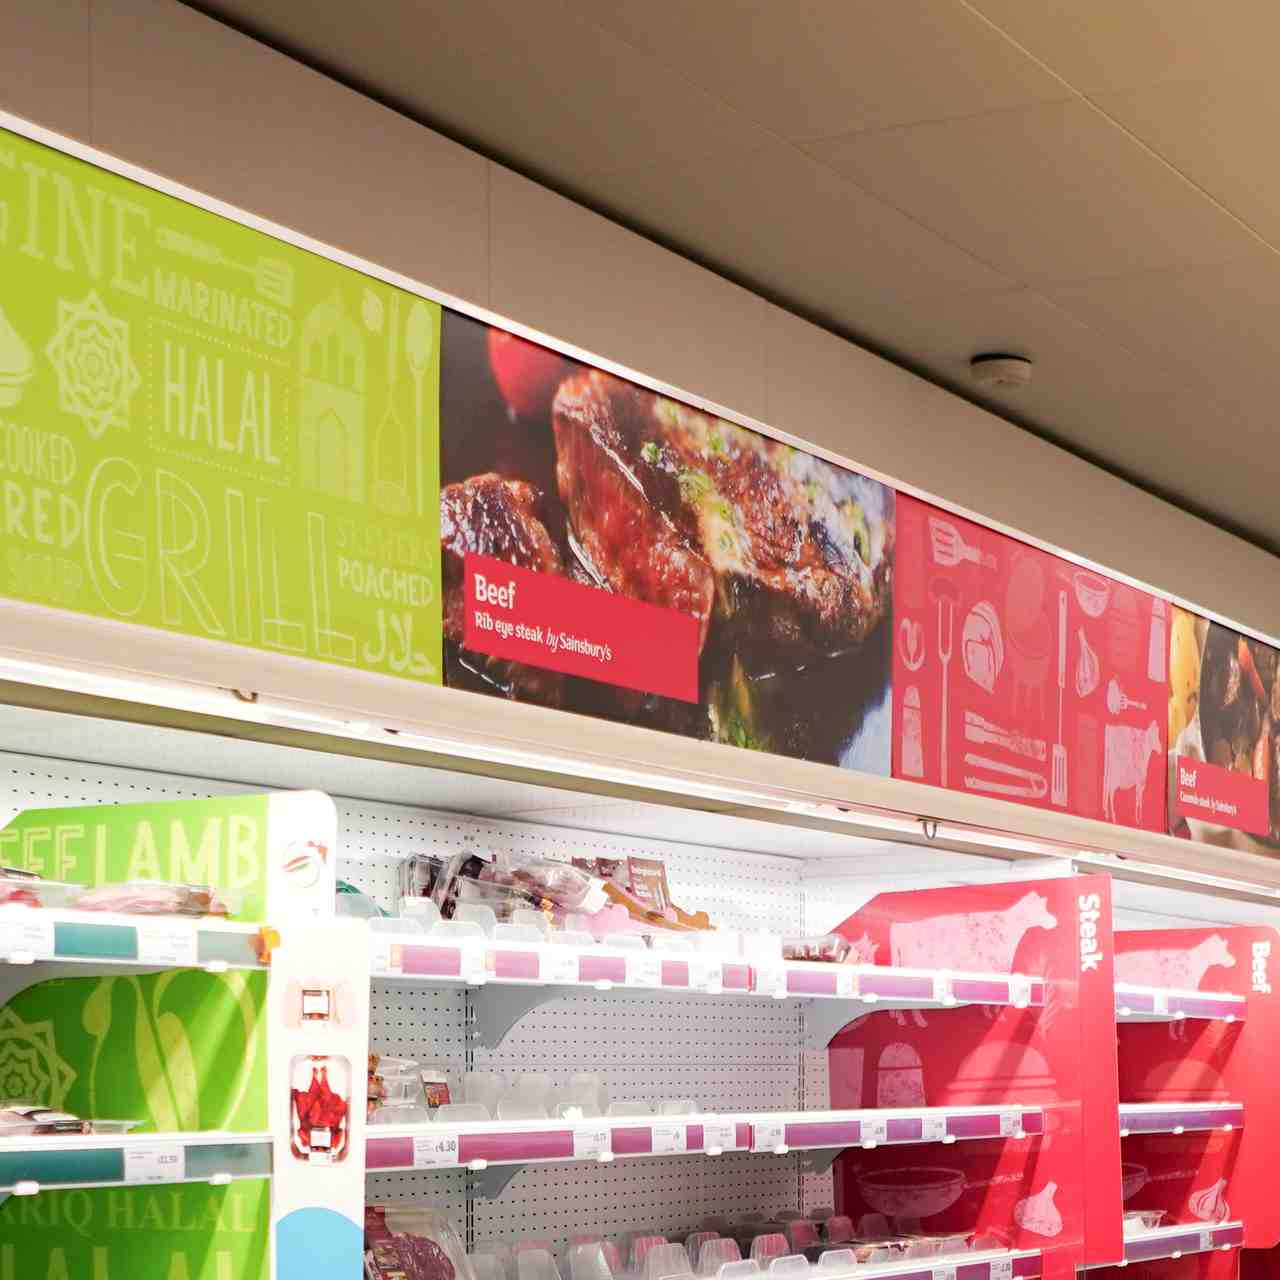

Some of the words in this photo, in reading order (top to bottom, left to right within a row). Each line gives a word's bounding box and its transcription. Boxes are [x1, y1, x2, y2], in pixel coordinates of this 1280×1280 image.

[153, 268, 293, 350] MARINATED
[164, 341, 280, 465] HALAL
[84, 456, 357, 664] GRILL
[338, 556, 433, 607] POACHED
[474, 573, 517, 610] Beef
[475, 611, 495, 631] Rib
[495, 617, 514, 640] eye
[516, 623, 544, 644] steak
[546, 627, 560, 653] by
[560, 632, 613, 663] Sainsbury's
[95, 814, 261, 888] LAMB
[1078, 893, 1103, 973] Steak
[1251, 940, 1272, 994] Beef
[108, 1190, 259, 1233] HALAL
